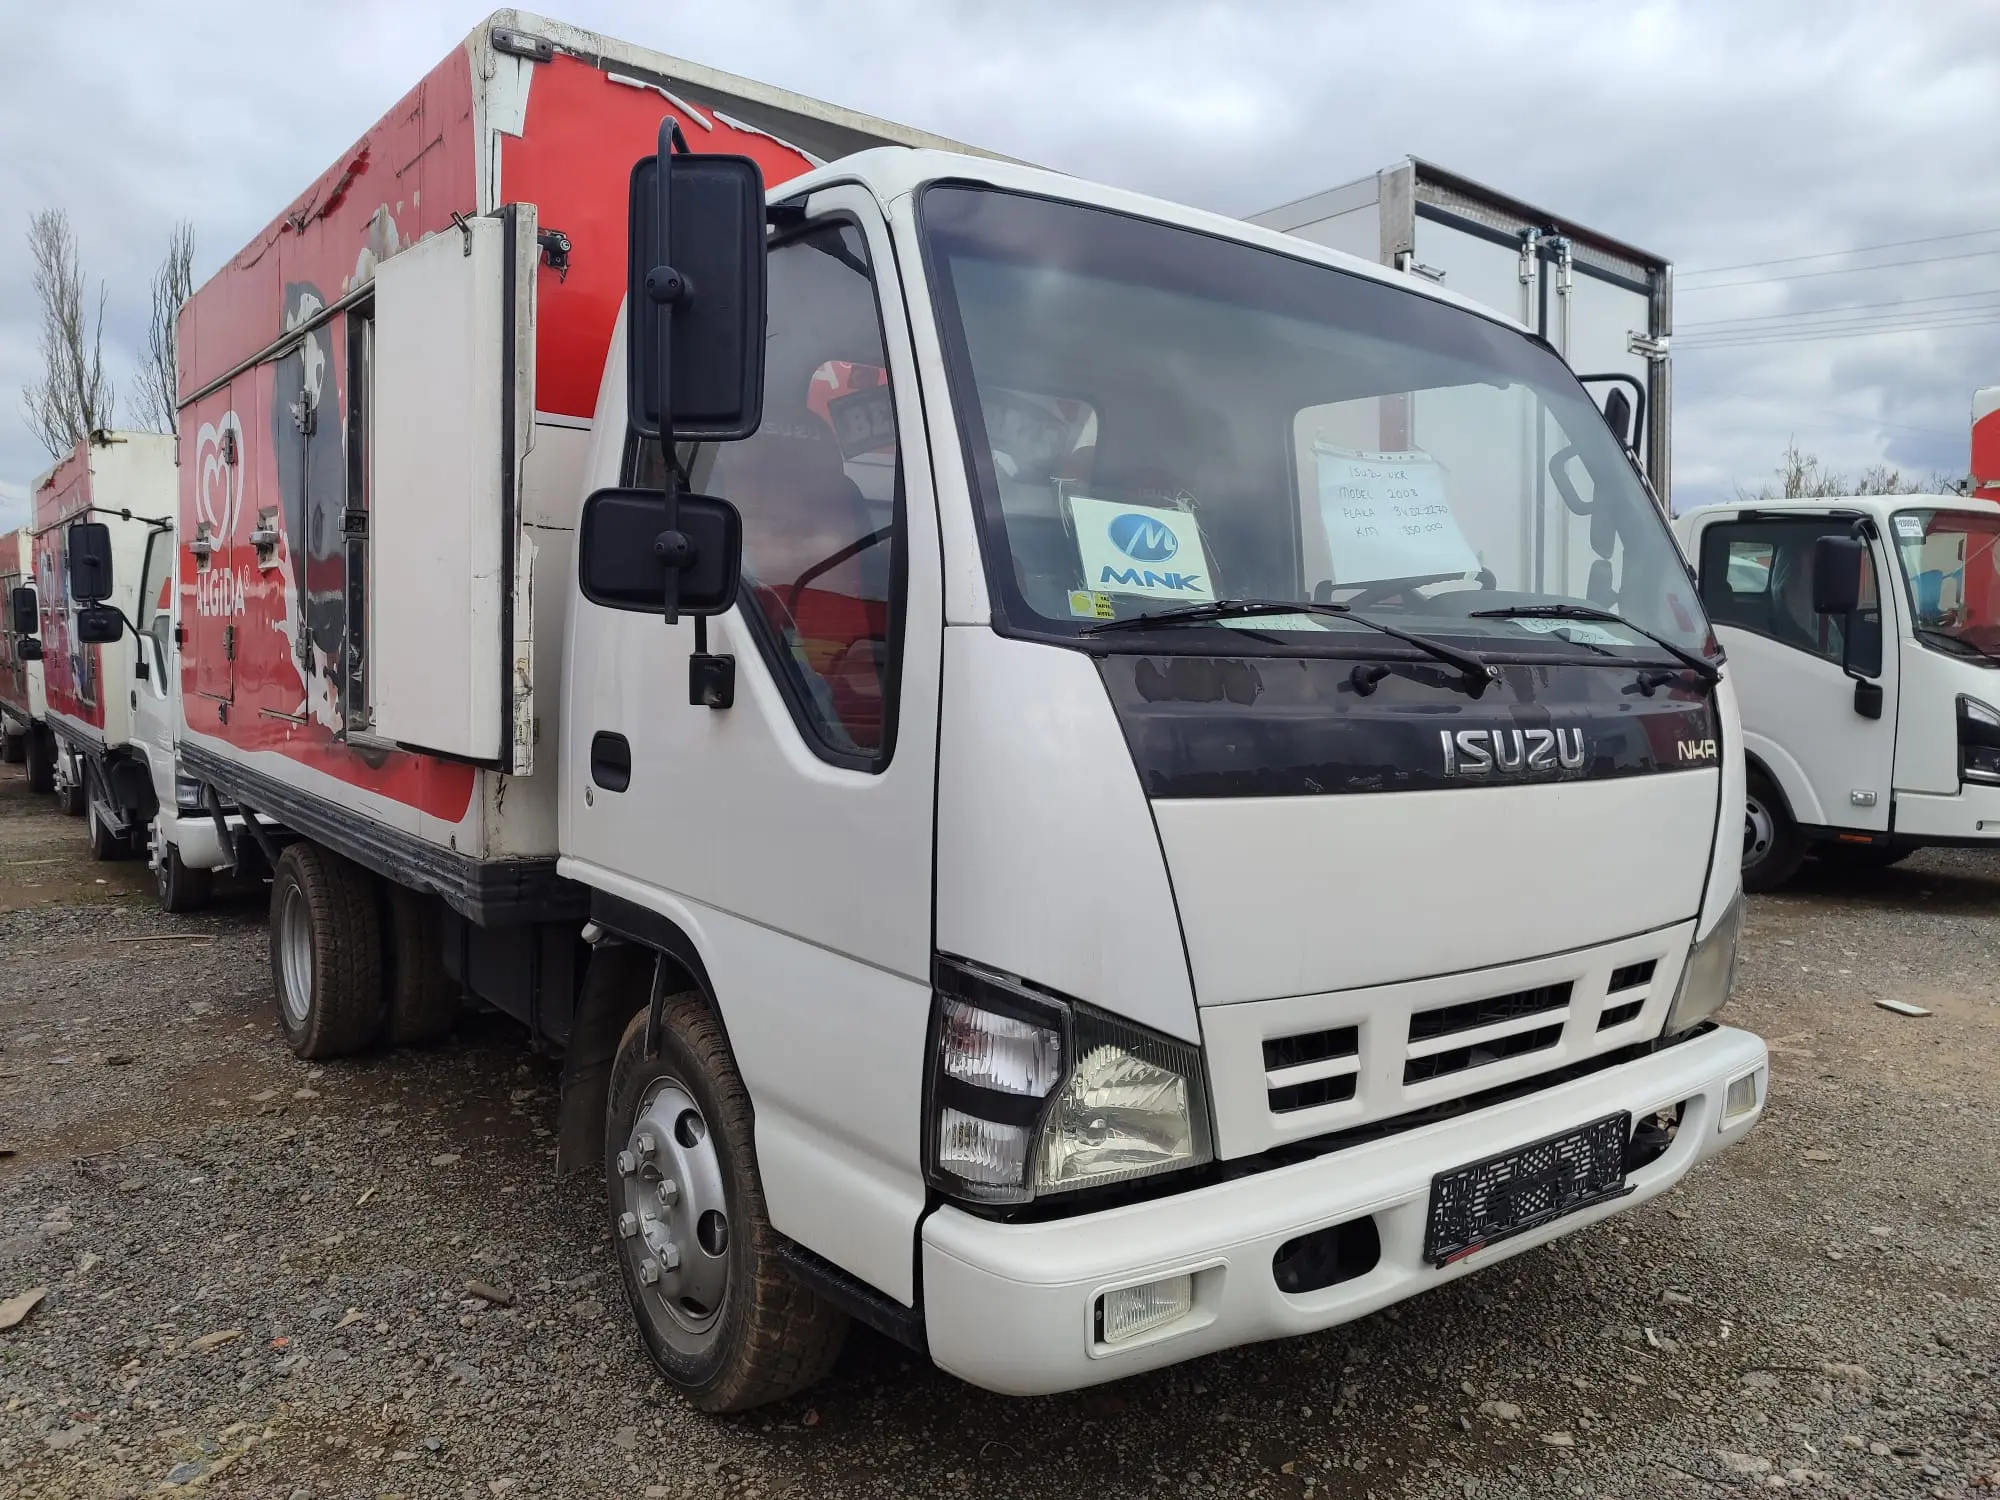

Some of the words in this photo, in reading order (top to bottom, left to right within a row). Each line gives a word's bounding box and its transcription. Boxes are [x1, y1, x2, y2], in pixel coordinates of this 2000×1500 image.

[1339, 486, 1374, 500] MODEL
[1343, 507, 1376, 520] PLAKA
[1356, 526, 1379, 537] KM
[1099, 565, 1205, 593] MNK
[1439, 727, 1585, 778] ISUZU
[1677, 739, 1717, 761] NKR
